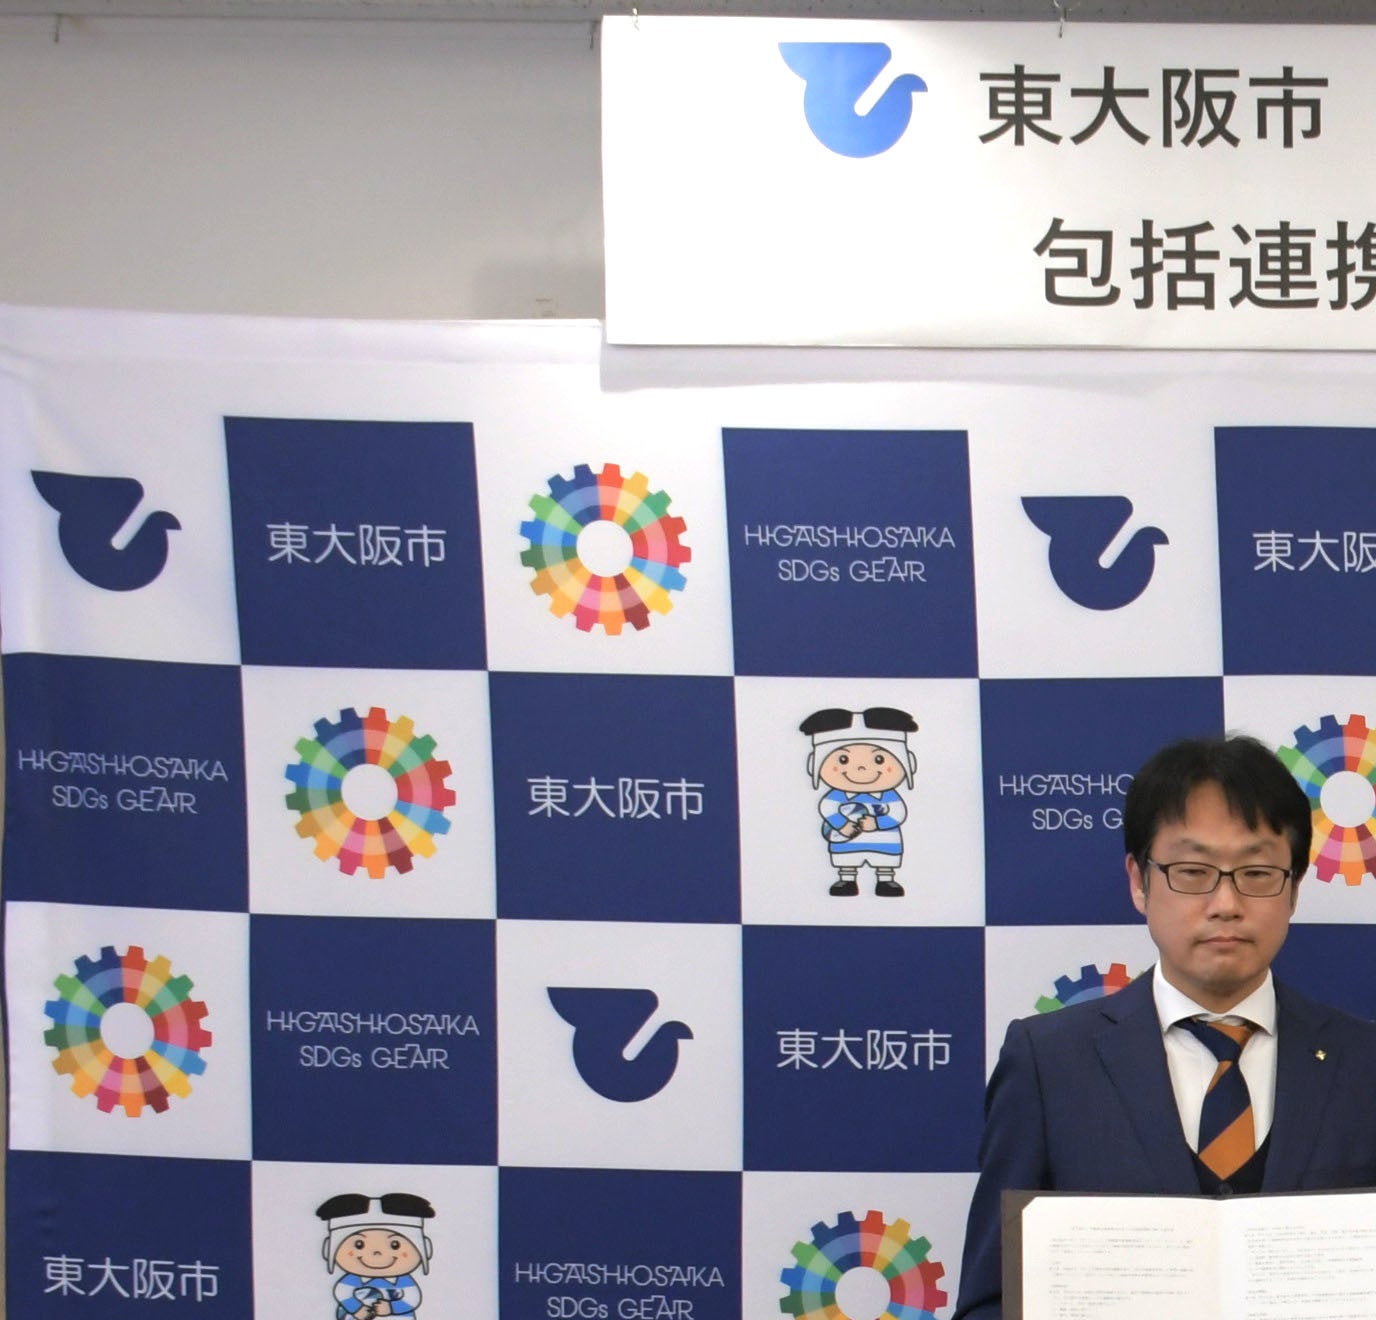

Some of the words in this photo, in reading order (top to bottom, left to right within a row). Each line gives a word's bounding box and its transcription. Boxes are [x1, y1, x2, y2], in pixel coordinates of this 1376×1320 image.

[979, 64, 1328, 148] 東大阪市
[266, 522, 446, 567] 東大阪市
[745, 525, 955, 548] HIGASHIOSAKA
[778, 559, 840, 581] SDGs
[849, 556, 926, 582] GEAR
[19, 750, 228, 781] HIGASHIOSAKA
[52, 785, 108, 809] SDGs
[117, 786, 197, 814] GEAR
[527, 776, 704, 820] 東大阪市
[1032, 808, 1093, 830] SDGs
[267, 1011, 480, 1035] HIGASHIOSAKA
[300, 1045, 362, 1067] SDGs
[371, 1044, 449, 1069] GEAR
[777, 1028, 952, 1070] 東大阪市
[43, 1254, 219, 1302] 東大阪市
[515, 1262, 725, 1287] HIGASHIOSAKA
[547, 1296, 608, 1318] SDGs
[618, 1295, 694, 1320] GEAR
